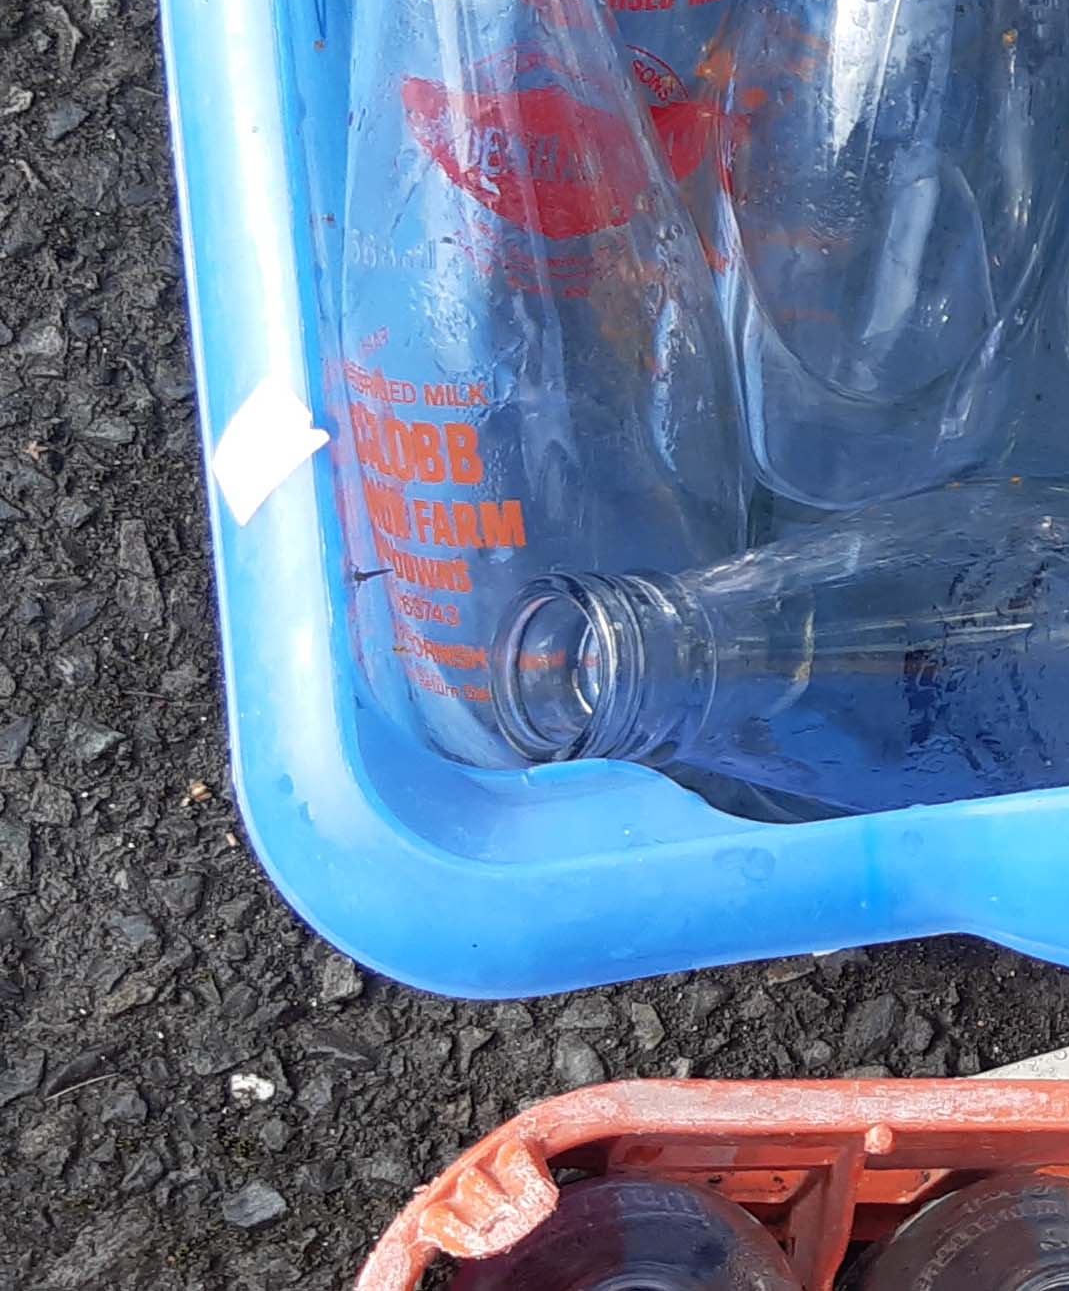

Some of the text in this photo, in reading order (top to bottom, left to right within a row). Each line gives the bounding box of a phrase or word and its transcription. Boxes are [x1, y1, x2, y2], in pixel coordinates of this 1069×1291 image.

[423, 381, 489, 408] MILK
[412, 499, 527, 548] FARM
[391, 549, 473, 593] DOWNS
